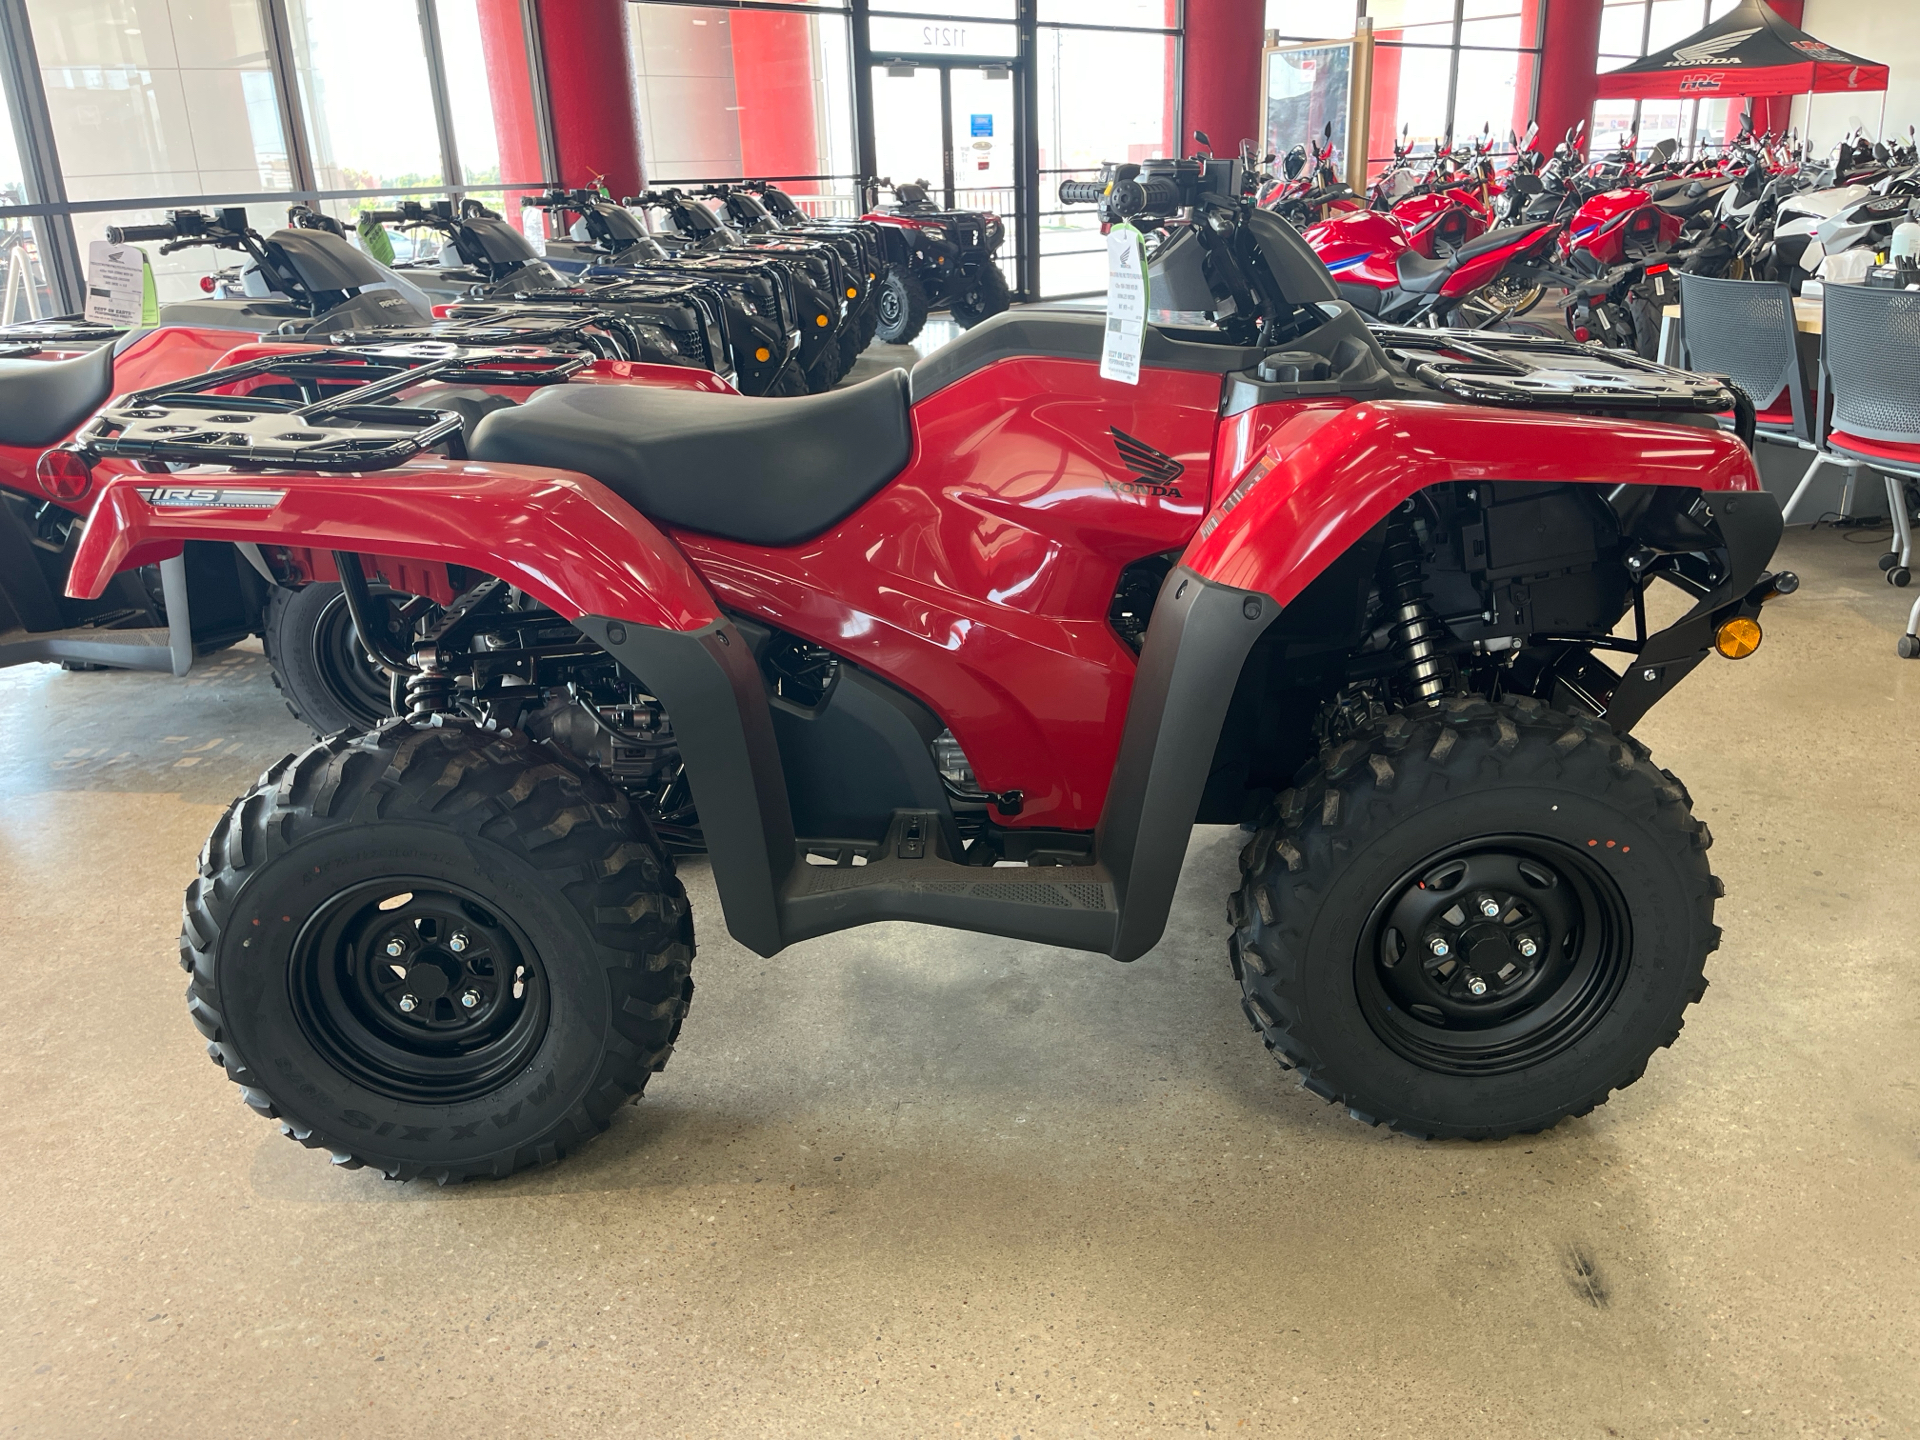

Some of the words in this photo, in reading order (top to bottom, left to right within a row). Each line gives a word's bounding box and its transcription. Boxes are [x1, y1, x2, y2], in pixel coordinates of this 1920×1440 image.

[1663, 57, 1742, 68] HONDA
[1680, 73, 1725, 90] HRC
[152, 489, 218, 501] IRS
[1103, 480, 1184, 498] HONDA
[338, 1069, 557, 1143] MAXXIS
